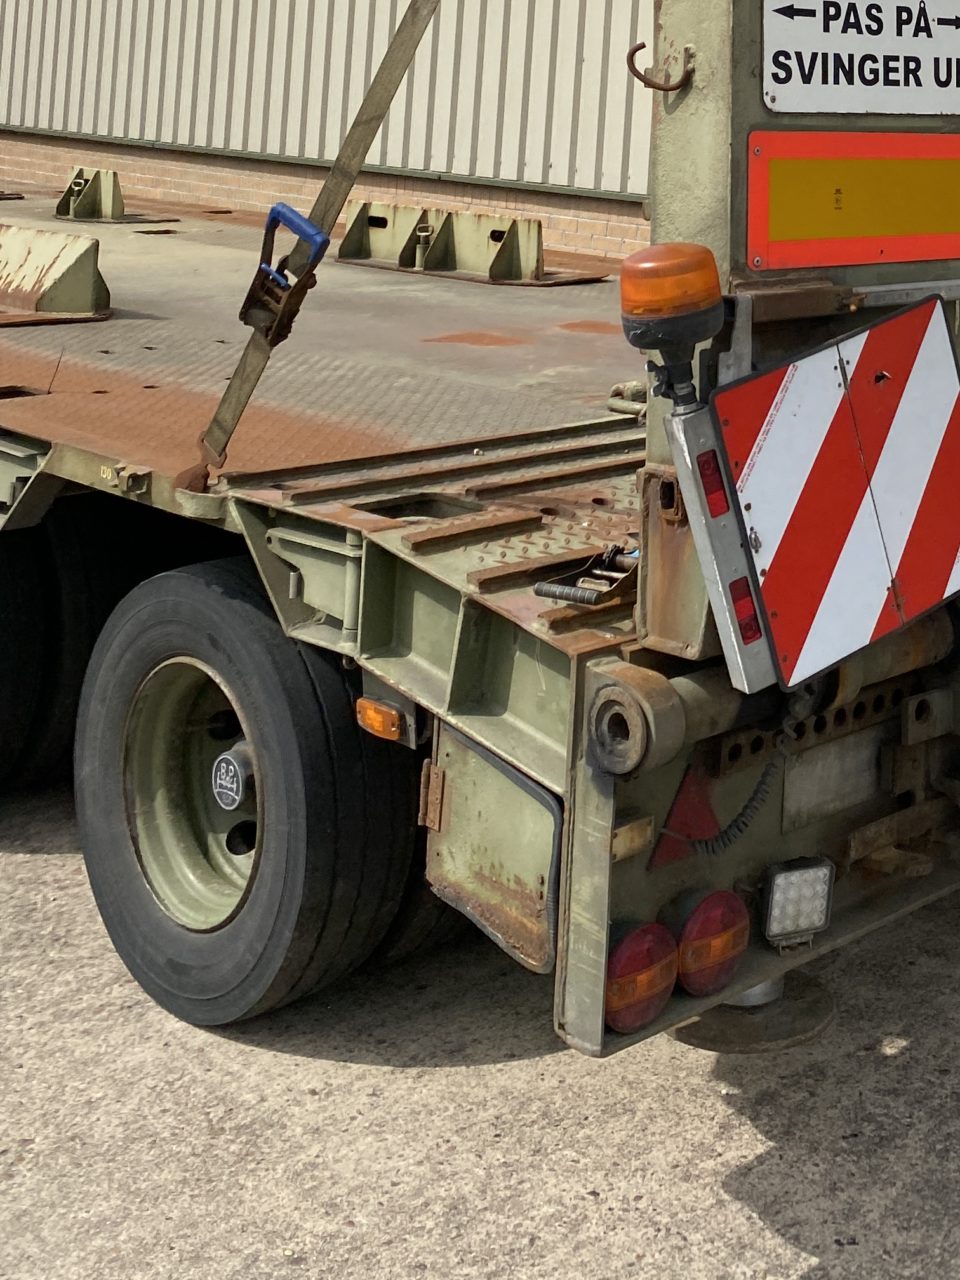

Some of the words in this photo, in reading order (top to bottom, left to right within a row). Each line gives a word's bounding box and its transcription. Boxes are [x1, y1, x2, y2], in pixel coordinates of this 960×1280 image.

[822, 0, 884, 36] PAS
[895, 0, 933, 38] PÅ
[771, 50, 923, 88] SVINGER
